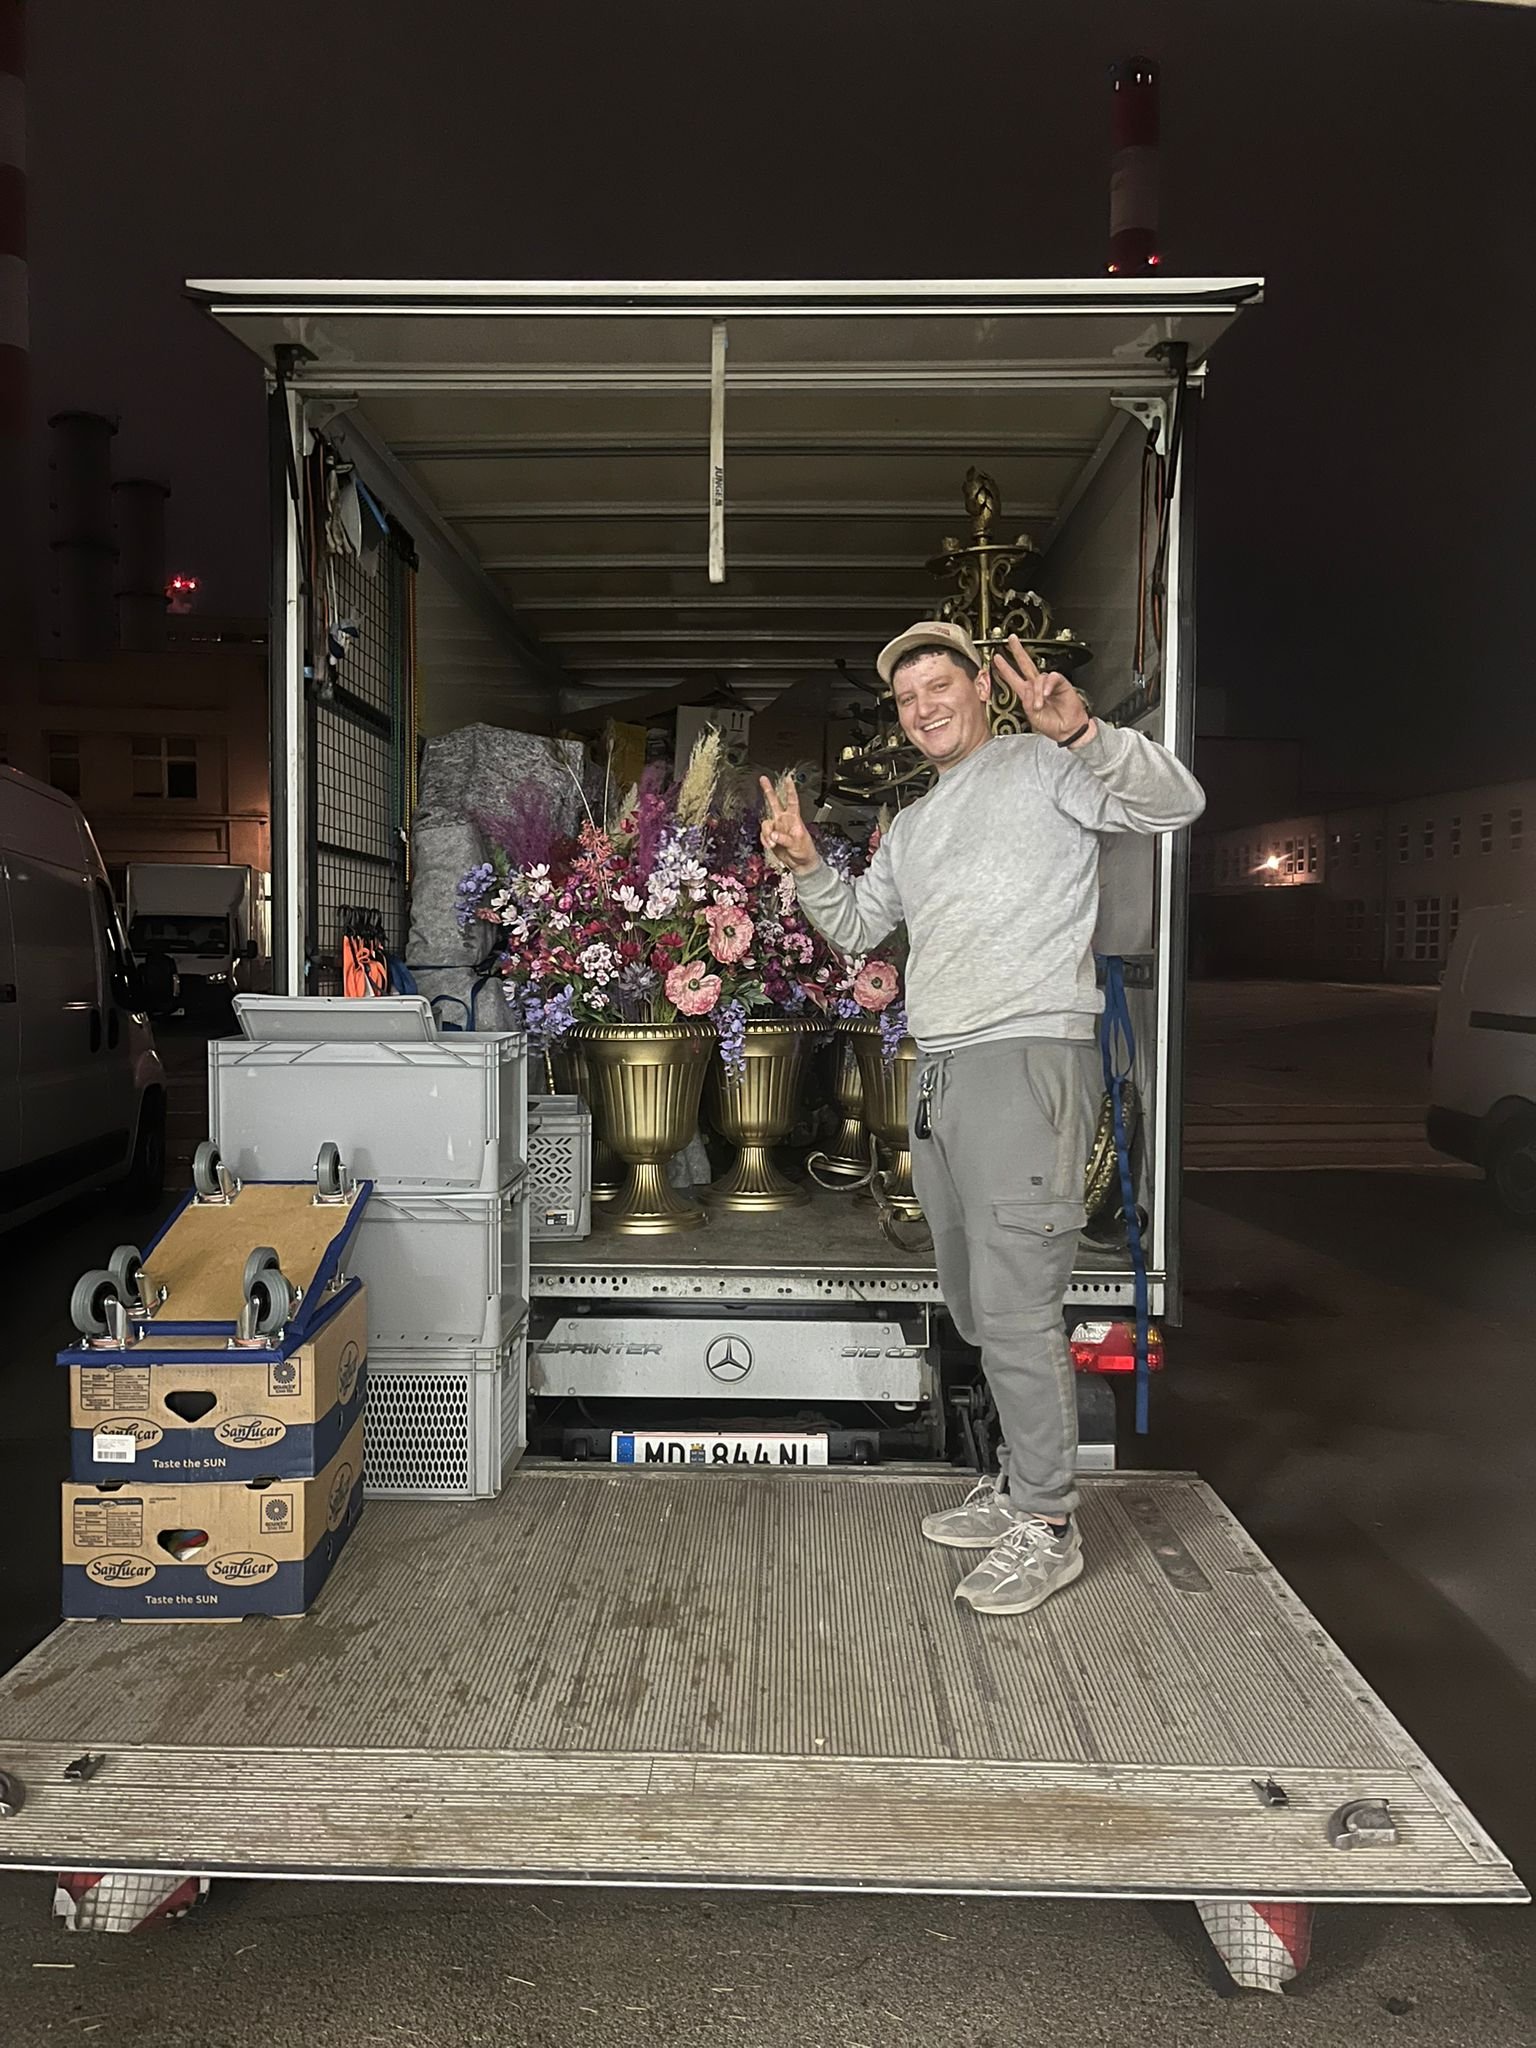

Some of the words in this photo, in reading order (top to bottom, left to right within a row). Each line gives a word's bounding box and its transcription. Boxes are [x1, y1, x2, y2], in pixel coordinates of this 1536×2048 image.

[536, 1343, 663, 1356] SPRINTER
[841, 1346, 881, 1358] 316
[220, 1420, 281, 1443] SanLucar
[645, 1442, 685, 1464] MD
[712, 1443, 770, 1464] 844
[152, 1459, 181, 1468] Taste
[183, 1459, 201, 1468] the
[203, 1458, 227, 1467] SUN
[92, 1560, 152, 1581] SanLucar
[212, 1558, 274, 1580] SanLucar
[145, 1595, 173, 1604] Taste
[175, 1594, 193, 1604] the
[195, 1594, 218, 1604] SUN
